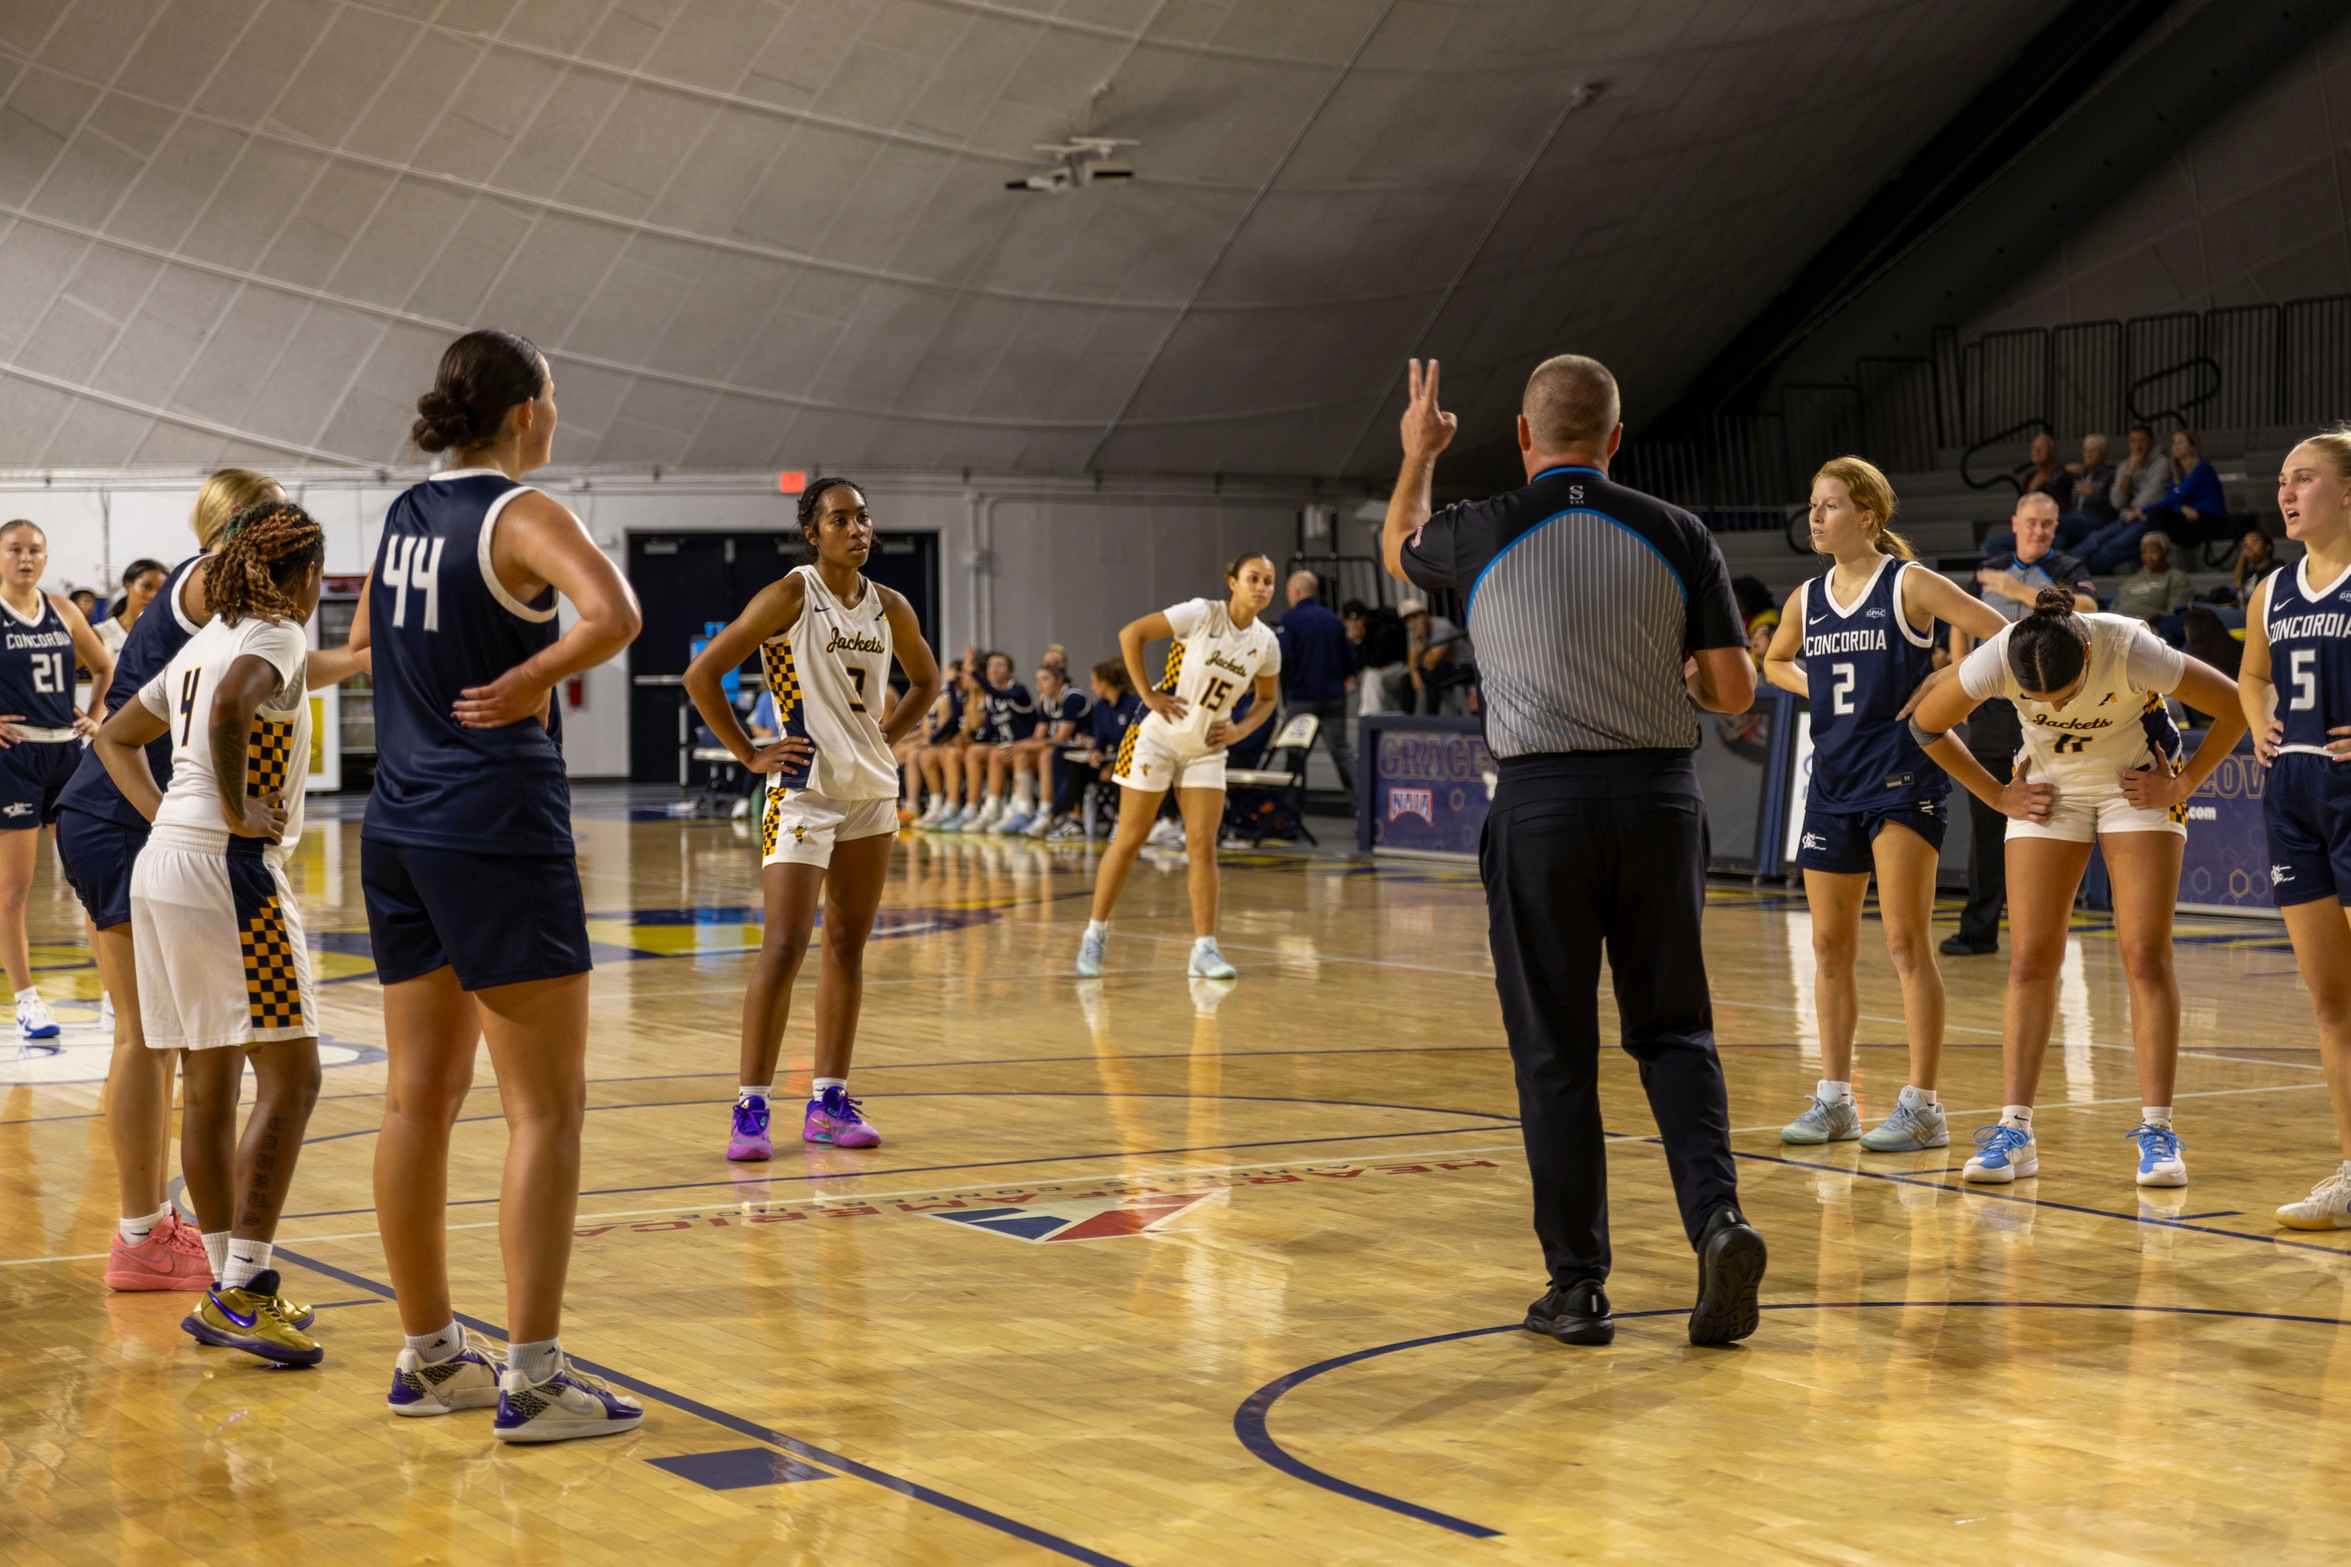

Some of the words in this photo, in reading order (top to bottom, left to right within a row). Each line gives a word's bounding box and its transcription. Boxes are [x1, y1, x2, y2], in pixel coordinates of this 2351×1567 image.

[382, 534, 446, 632] 44
[1866, 608, 1887, 618] GPAC
[826, 626, 885, 654] Jackets
[1805, 629, 1888, 657] CONCORDIA
[30, 652, 65, 693] 21
[1205, 649, 1247, 678] Jackets
[2289, 648, 2316, 711] 5
[1199, 676, 1234, 712] 15
[1832, 662, 1855, 716] 2
[179, 666, 202, 748] 4
[2032, 713, 2113, 730] Jackets
[1193, 1160, 1500, 1190] HEART
[1072, 1187, 1162, 1200] OF
[573, 1194, 1038, 1238] AMERICA
